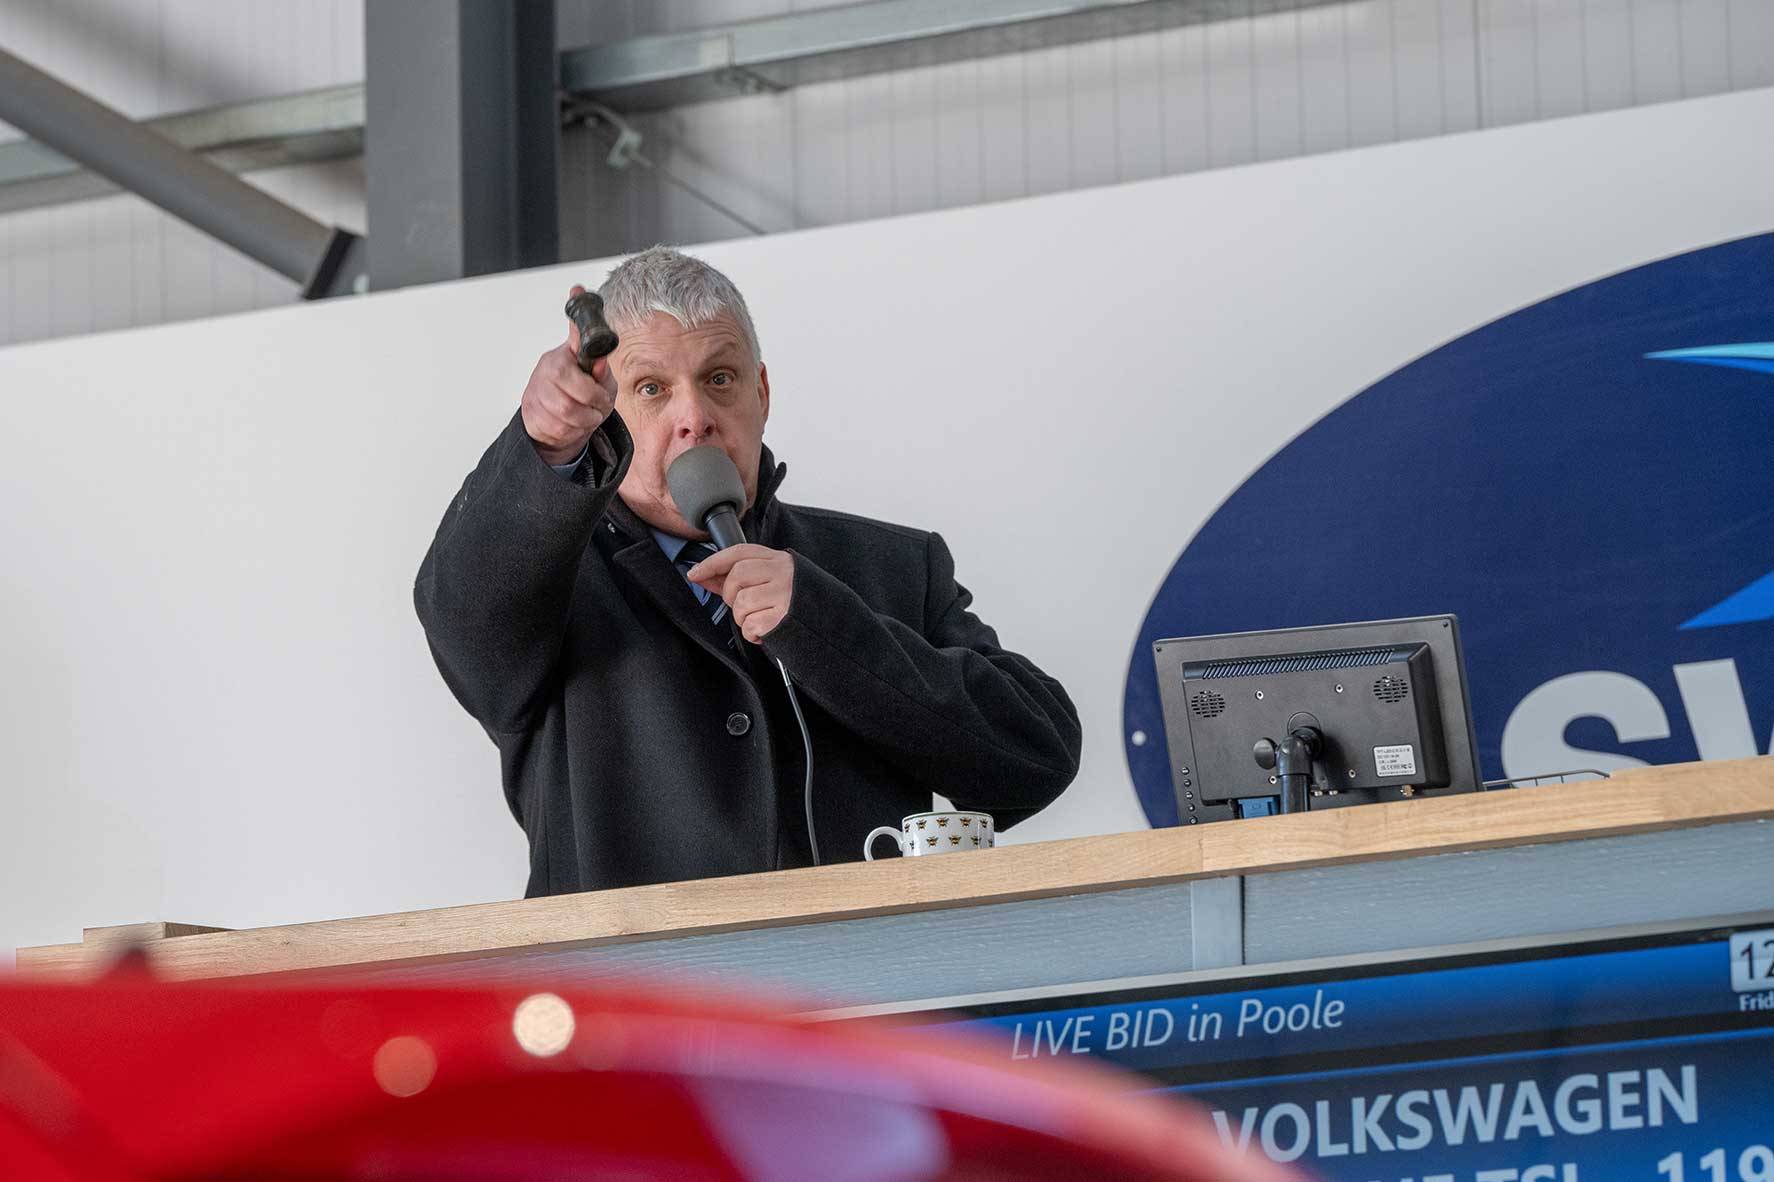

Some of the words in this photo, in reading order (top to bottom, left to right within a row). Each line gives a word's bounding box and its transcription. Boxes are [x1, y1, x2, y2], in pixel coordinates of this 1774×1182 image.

[1012, 1015, 1094, 1060] LIVE
[1106, 1008, 1174, 1051] BID
[1187, 1003, 1223, 1042] in
[1237, 989, 1345, 1038] Poole
[1211, 1064, 1699, 1163] VOLKSWAGEN
